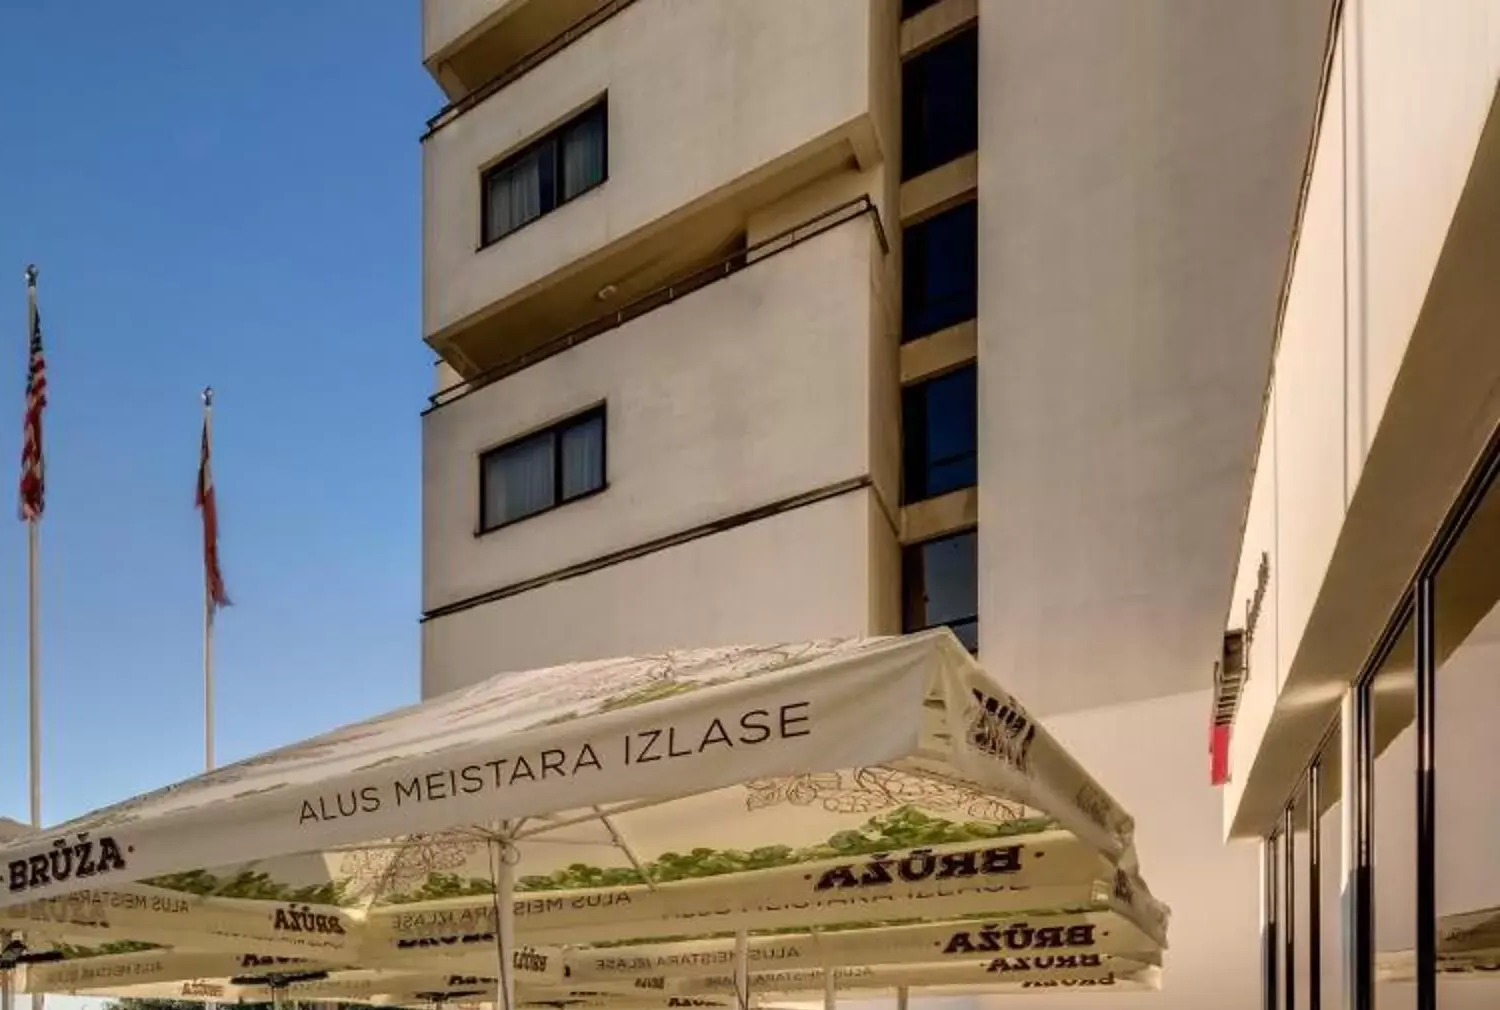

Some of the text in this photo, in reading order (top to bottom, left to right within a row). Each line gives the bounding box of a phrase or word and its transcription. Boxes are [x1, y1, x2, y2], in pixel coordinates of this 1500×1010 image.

[299, 701, 812, 825] ALUS MEISTARA IZLASE
